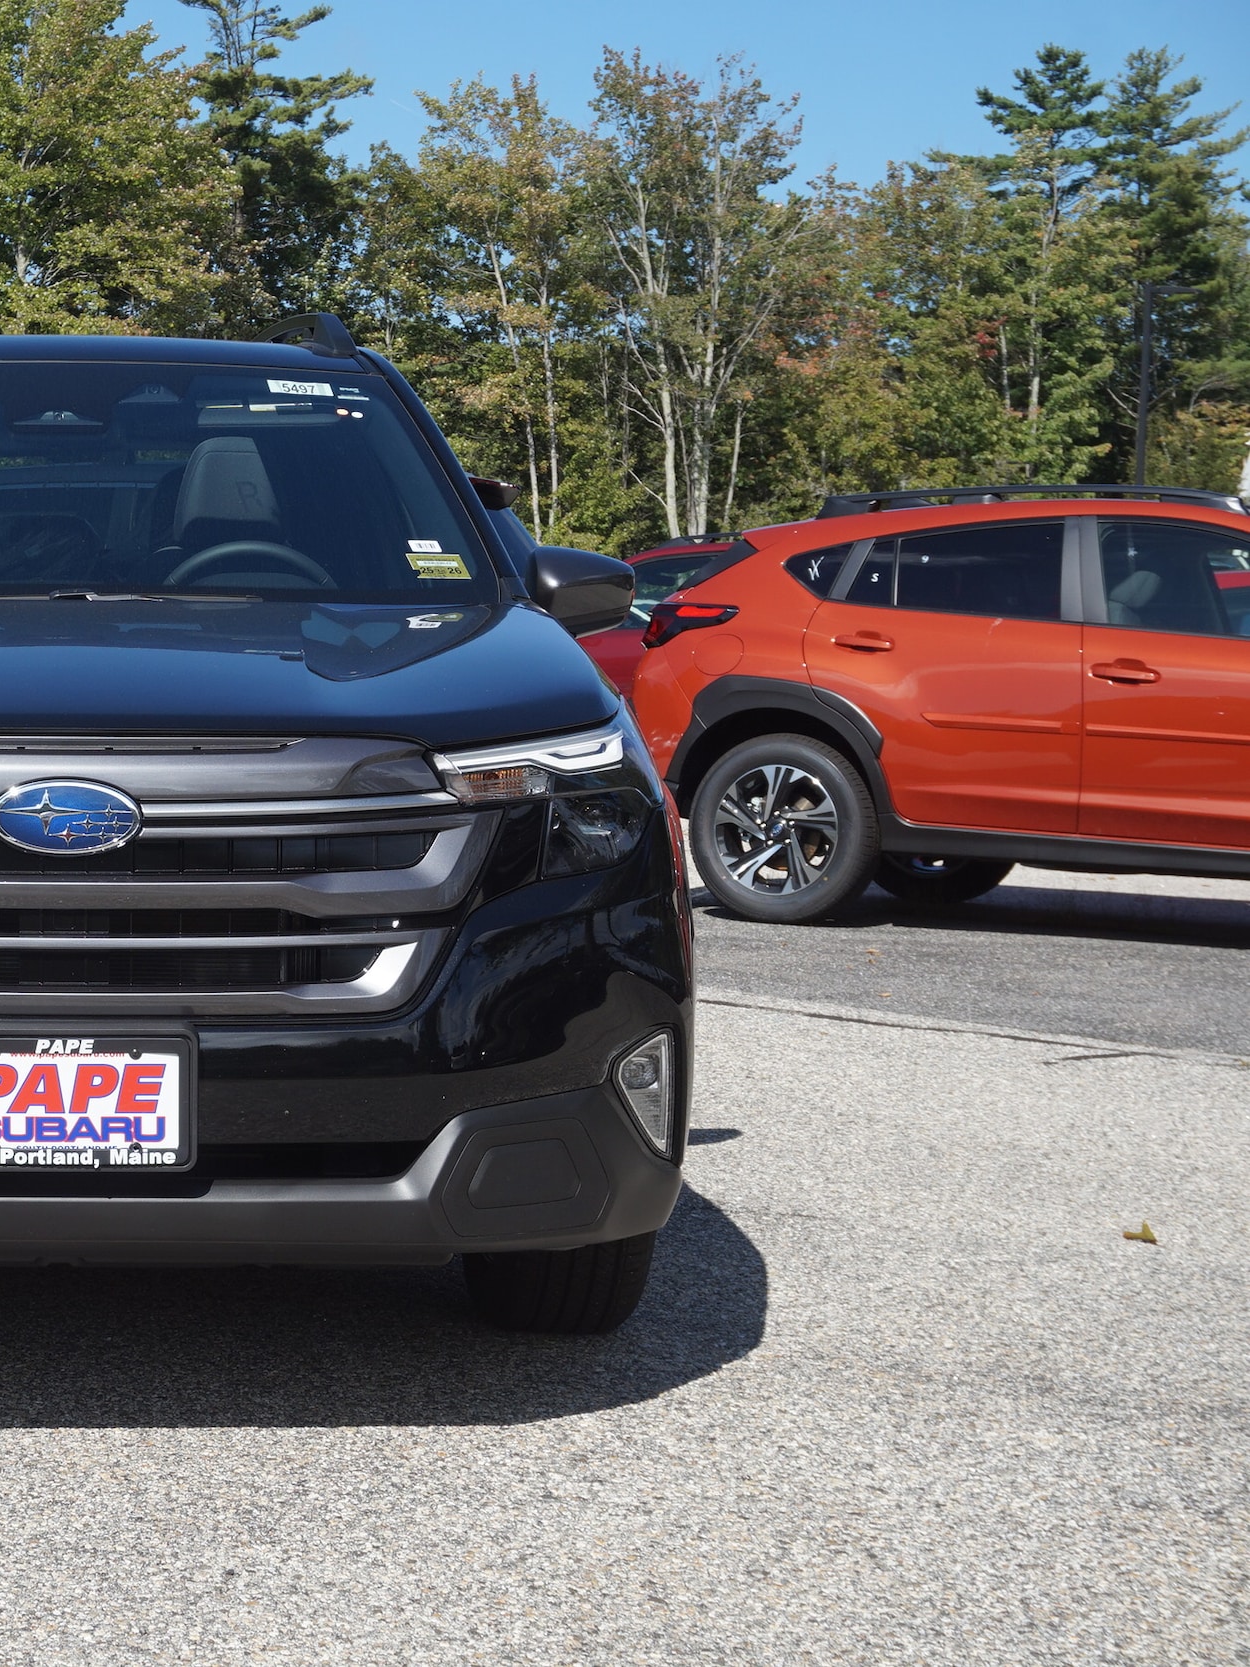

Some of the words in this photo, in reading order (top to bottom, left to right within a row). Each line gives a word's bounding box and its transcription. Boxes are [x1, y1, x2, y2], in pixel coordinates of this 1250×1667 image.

[281, 383, 316, 394] 5497
[420, 566, 434, 575] 25
[447, 567, 462, 575] 26
[35, 1039, 95, 1054] PAPE
[1, 1148, 100, 1169] Portland,
[109, 1149, 177, 1165] Maine
